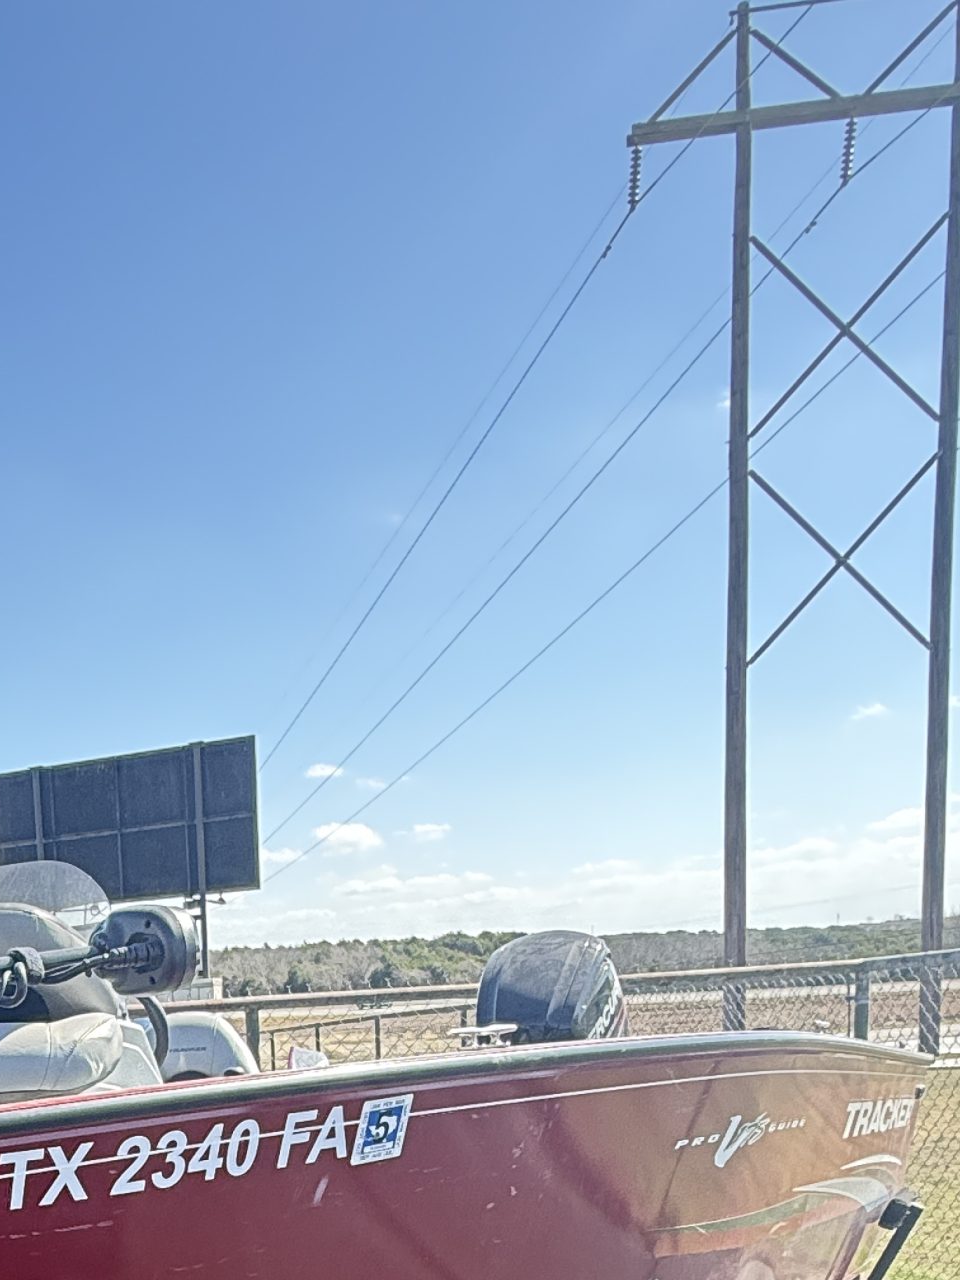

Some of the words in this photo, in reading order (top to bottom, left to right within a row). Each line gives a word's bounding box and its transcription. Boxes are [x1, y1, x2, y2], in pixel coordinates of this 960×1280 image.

[109, 1119, 261, 1197] 2340
[277, 1105, 348, 1169] FA
[674, 1133, 721, 1150] PRO
[768, 1117, 807, 1133] GUIDE
